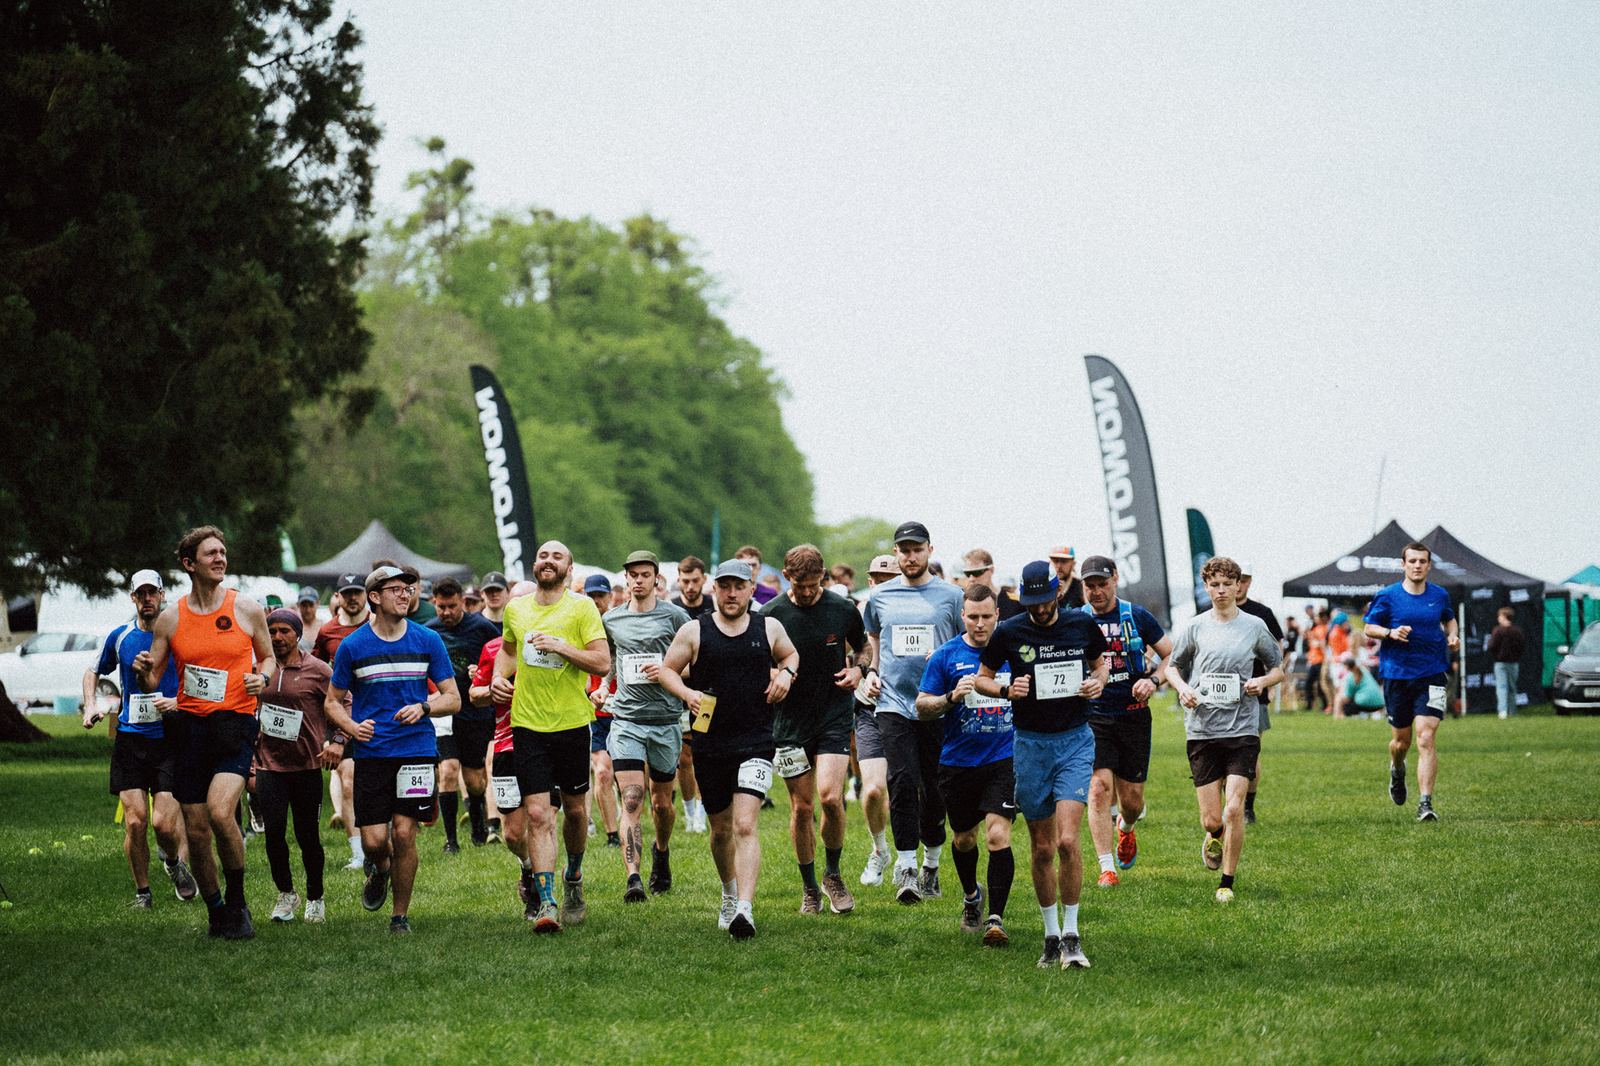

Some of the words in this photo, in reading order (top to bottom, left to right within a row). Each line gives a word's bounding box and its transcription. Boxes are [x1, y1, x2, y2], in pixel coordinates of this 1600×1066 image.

[906, 635, 919, 645] 101
[1040, 650, 1066, 659] Francis
[198, 678, 208, 688] 85
[1054, 674, 1066, 686] 72
[1212, 684, 1226, 693] 100
[138, 704, 148, 713] 61
[273, 716, 285, 728] 88
[268, 728, 287, 737] ABDER
[756, 768, 766, 780] 35
[412, 776, 422, 786] 84
[496, 788, 506, 798] 73
